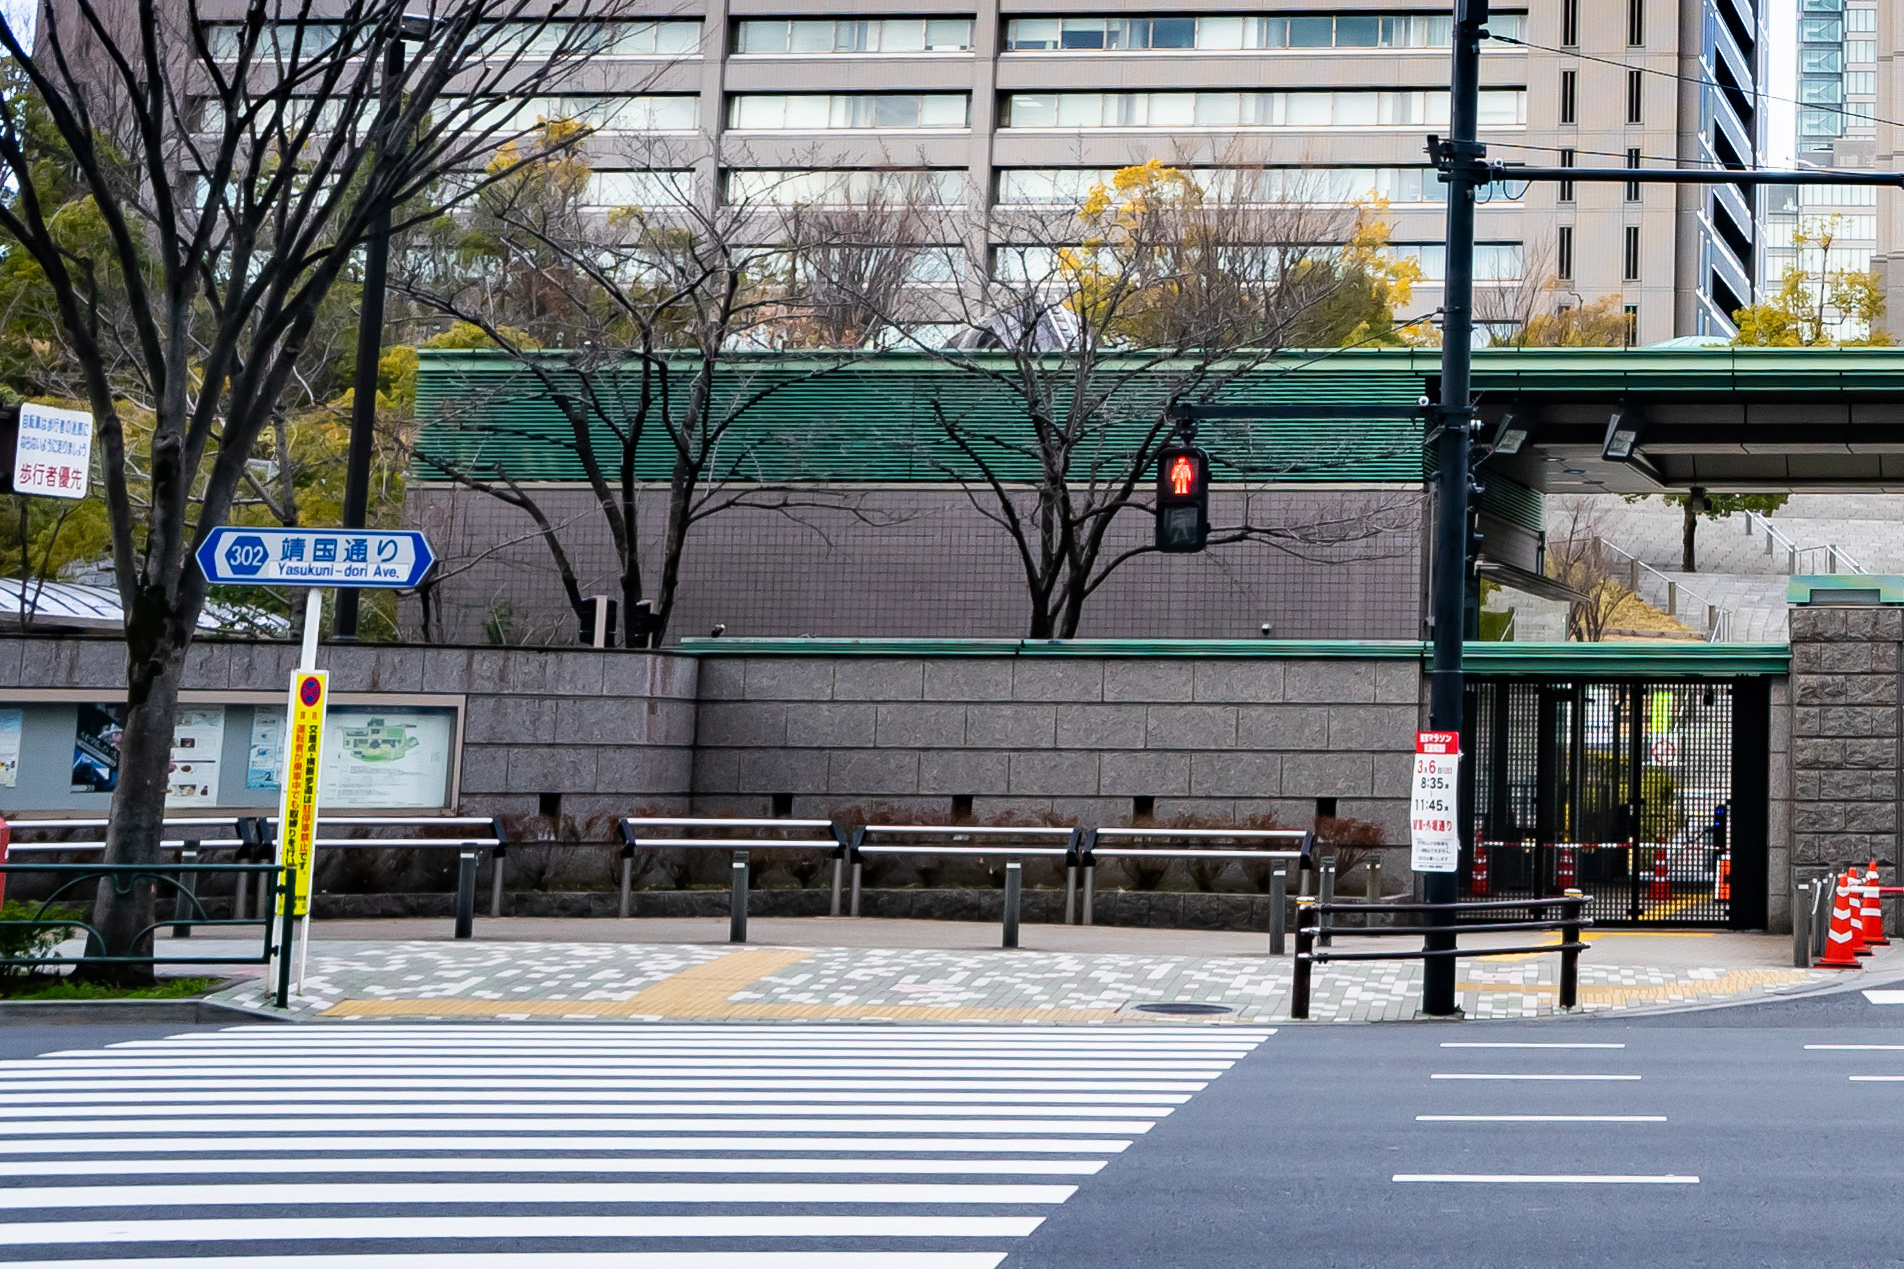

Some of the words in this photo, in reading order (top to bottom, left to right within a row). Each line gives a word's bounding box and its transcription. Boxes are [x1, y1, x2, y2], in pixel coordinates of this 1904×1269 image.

[19, 462, 83, 490] 歩行者優先
[229, 545, 264, 566] 302
[281, 537, 398, 563] 靖国通り
[278, 563, 368, 578] Yasukuni-dori
[373, 565, 400, 578] Ave.
